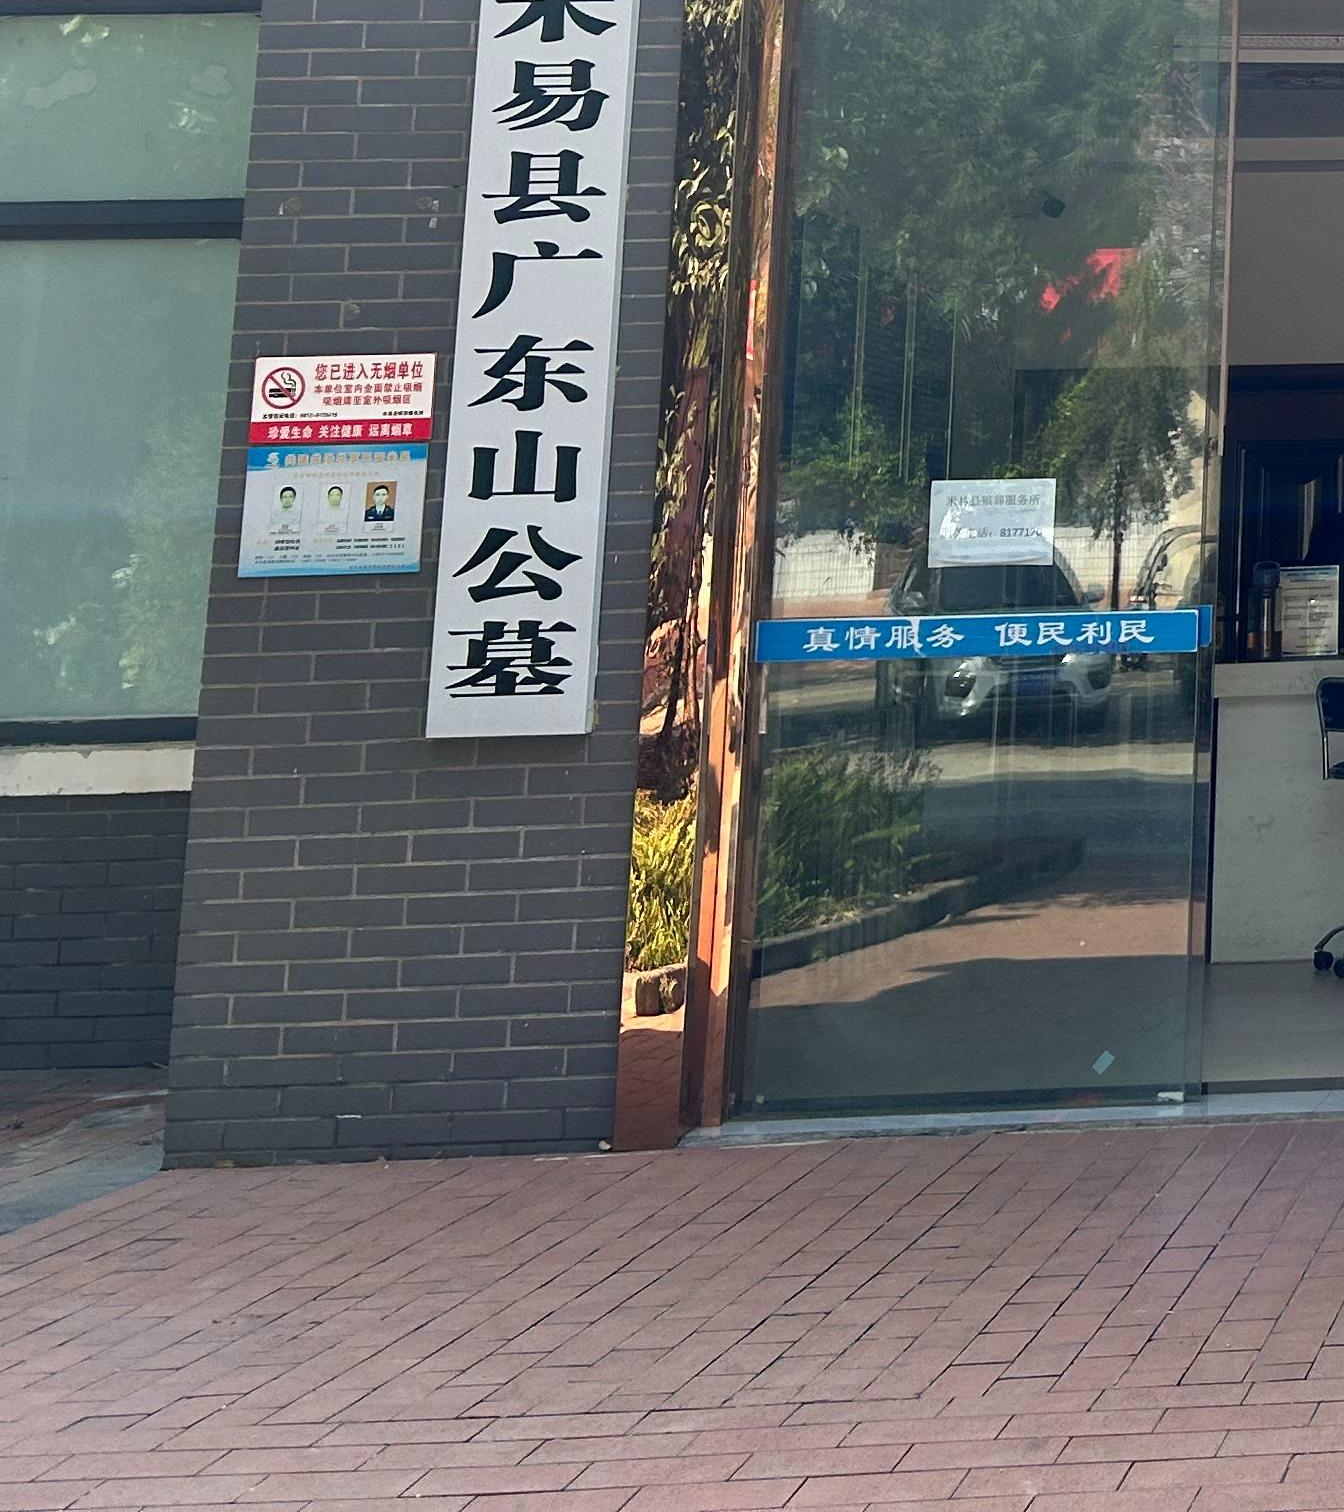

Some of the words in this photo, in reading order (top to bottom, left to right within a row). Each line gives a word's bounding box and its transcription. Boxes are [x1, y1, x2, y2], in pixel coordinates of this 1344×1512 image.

[314, 361, 424, 381] 您已进入无烟单位
[267, 425, 313, 439] 珍爱生命
[318, 424, 364, 438] 关注健康
[801, 623, 966, 654] 真情服务
[994, 618, 1155, 648] 便民利民
